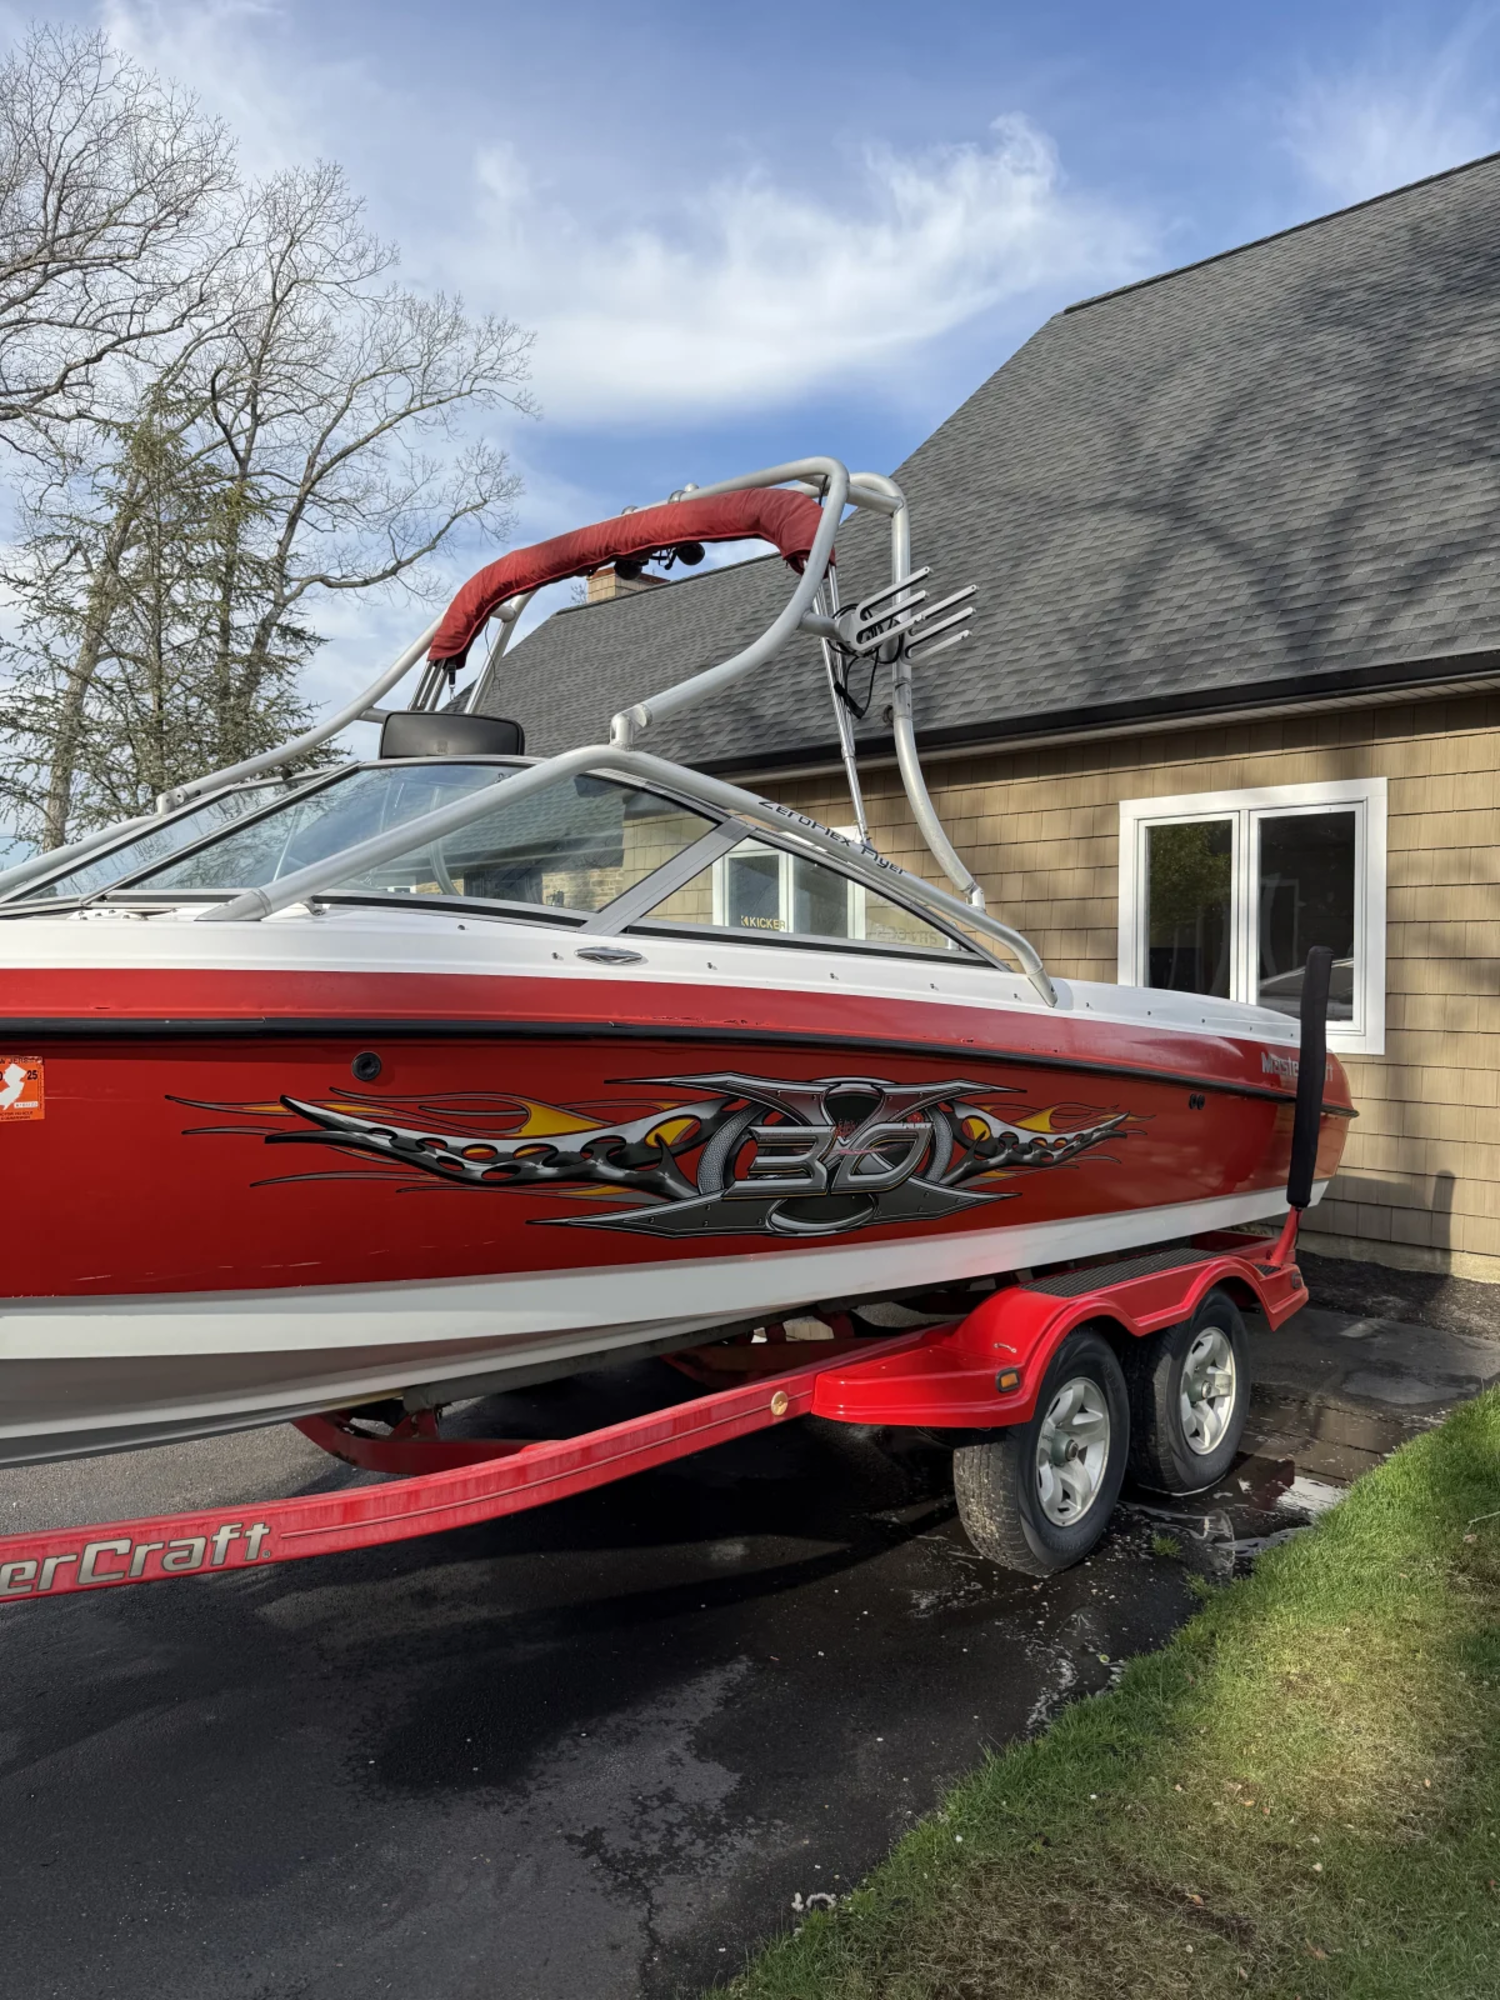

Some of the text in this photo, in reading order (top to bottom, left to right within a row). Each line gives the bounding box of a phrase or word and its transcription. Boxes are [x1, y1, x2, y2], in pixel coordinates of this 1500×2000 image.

[758, 800, 908, 875] ZeroFlex Flyer
[749, 916, 786, 930] KICKER
[27, 1070, 38, 1080] 25
[0, 1522, 271, 1597] erCraft
